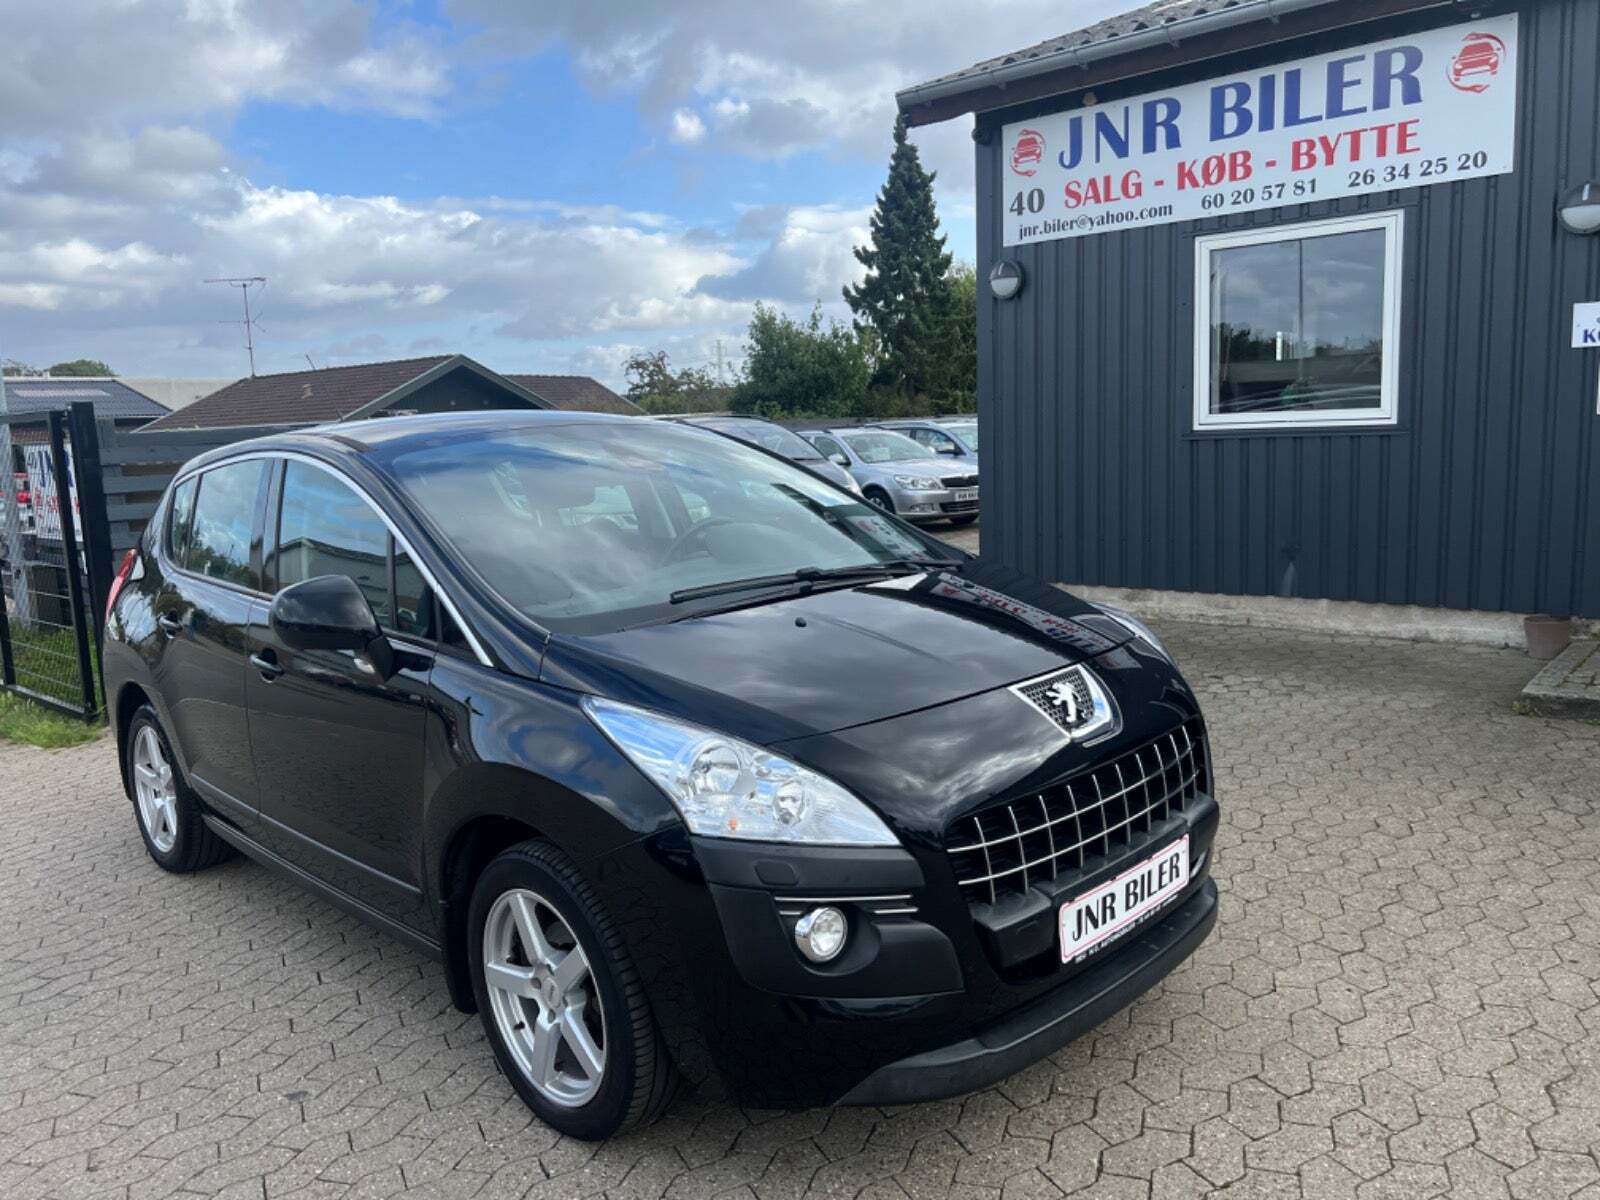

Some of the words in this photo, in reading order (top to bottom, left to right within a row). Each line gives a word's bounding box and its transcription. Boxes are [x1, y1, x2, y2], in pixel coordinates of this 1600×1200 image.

[1058, 96, 1182, 170] JNR
[1209, 45, 1424, 142] BILER
[1064, 169, 1143, 210] SALG
[1177, 150, 1253, 192] KØB
[1291, 118, 1421, 172] BYTTE
[1348, 168, 1376, 188] 26
[1383, 162, 1410, 182] 34
[1420, 156, 1448, 177] 25
[1457, 150, 1488, 171] 20
[1009, 188, 1046, 216] 40
[1201, 192, 1225, 210] 60
[1231, 187, 1255, 205] 20
[1261, 182, 1286, 201] 57
[1293, 177, 1316, 196] 81
[1019, 204, 1173, 240] jnr.biler@yahoo.com
[1072, 892, 1117, 942] JNR
[1125, 852, 1180, 912] BILER
